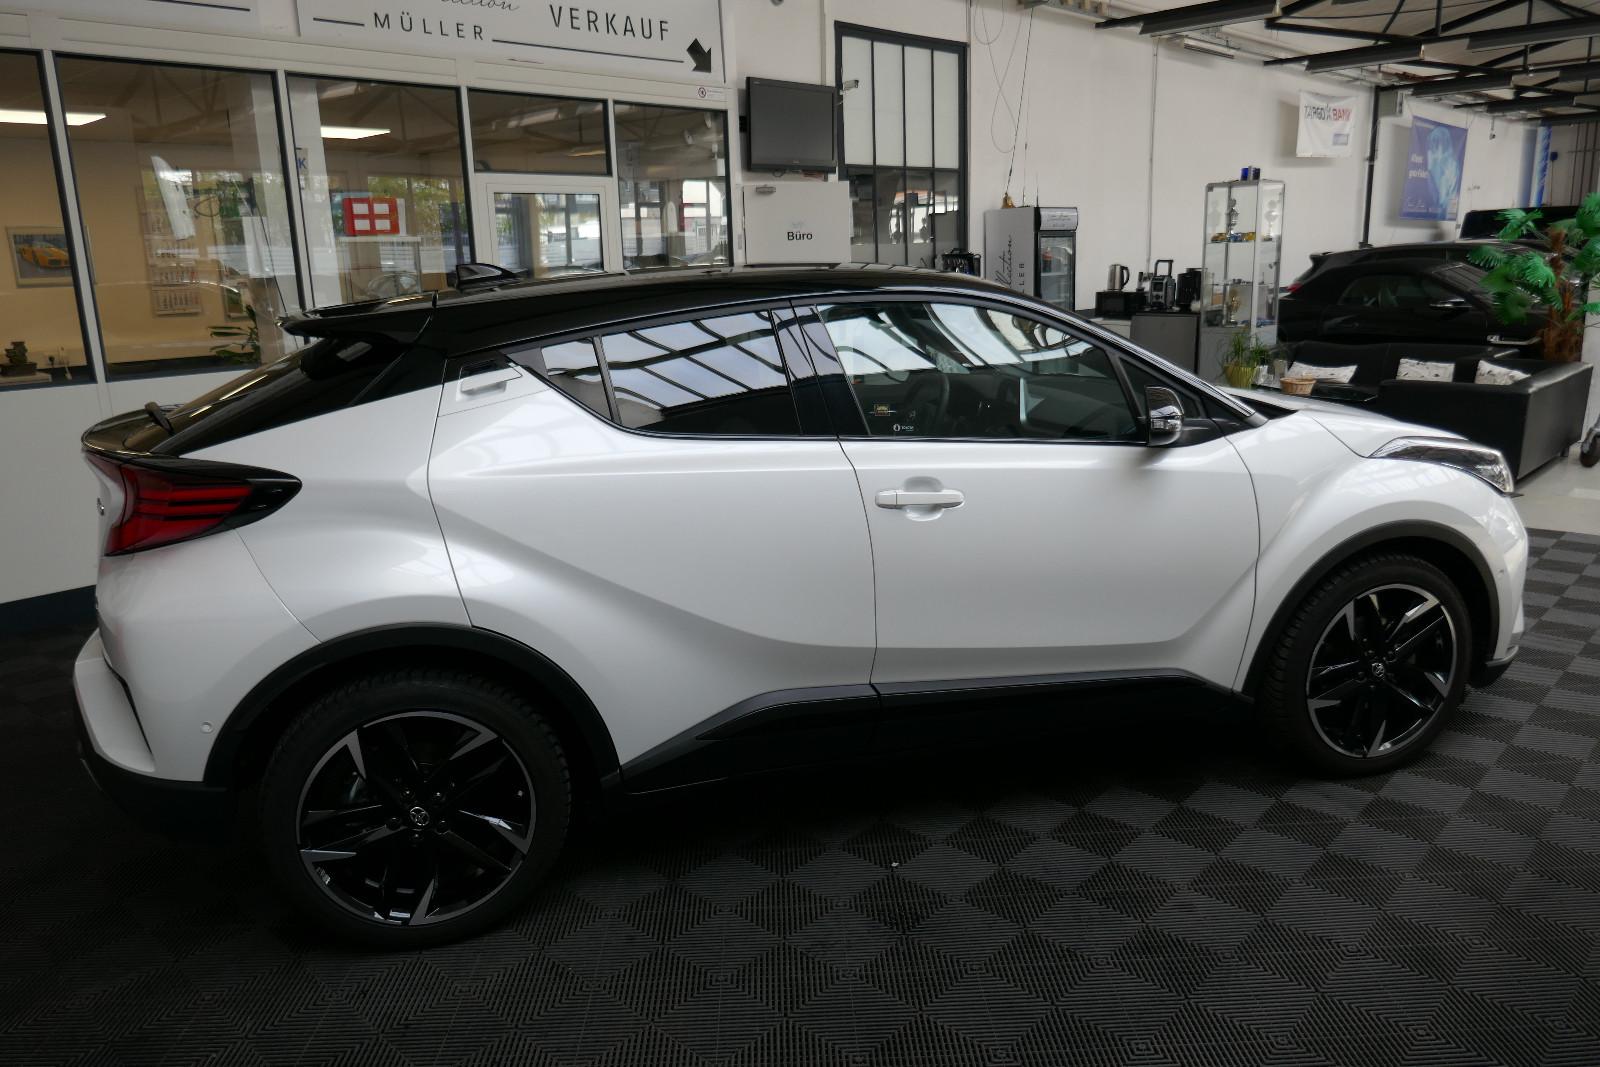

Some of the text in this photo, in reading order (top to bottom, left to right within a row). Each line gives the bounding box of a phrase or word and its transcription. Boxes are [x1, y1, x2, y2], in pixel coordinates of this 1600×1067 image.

[373, 11, 484, 41] MÜLLER
[549, 4, 669, 41] VERKAUF
[787, 231, 813, 241] Büro
